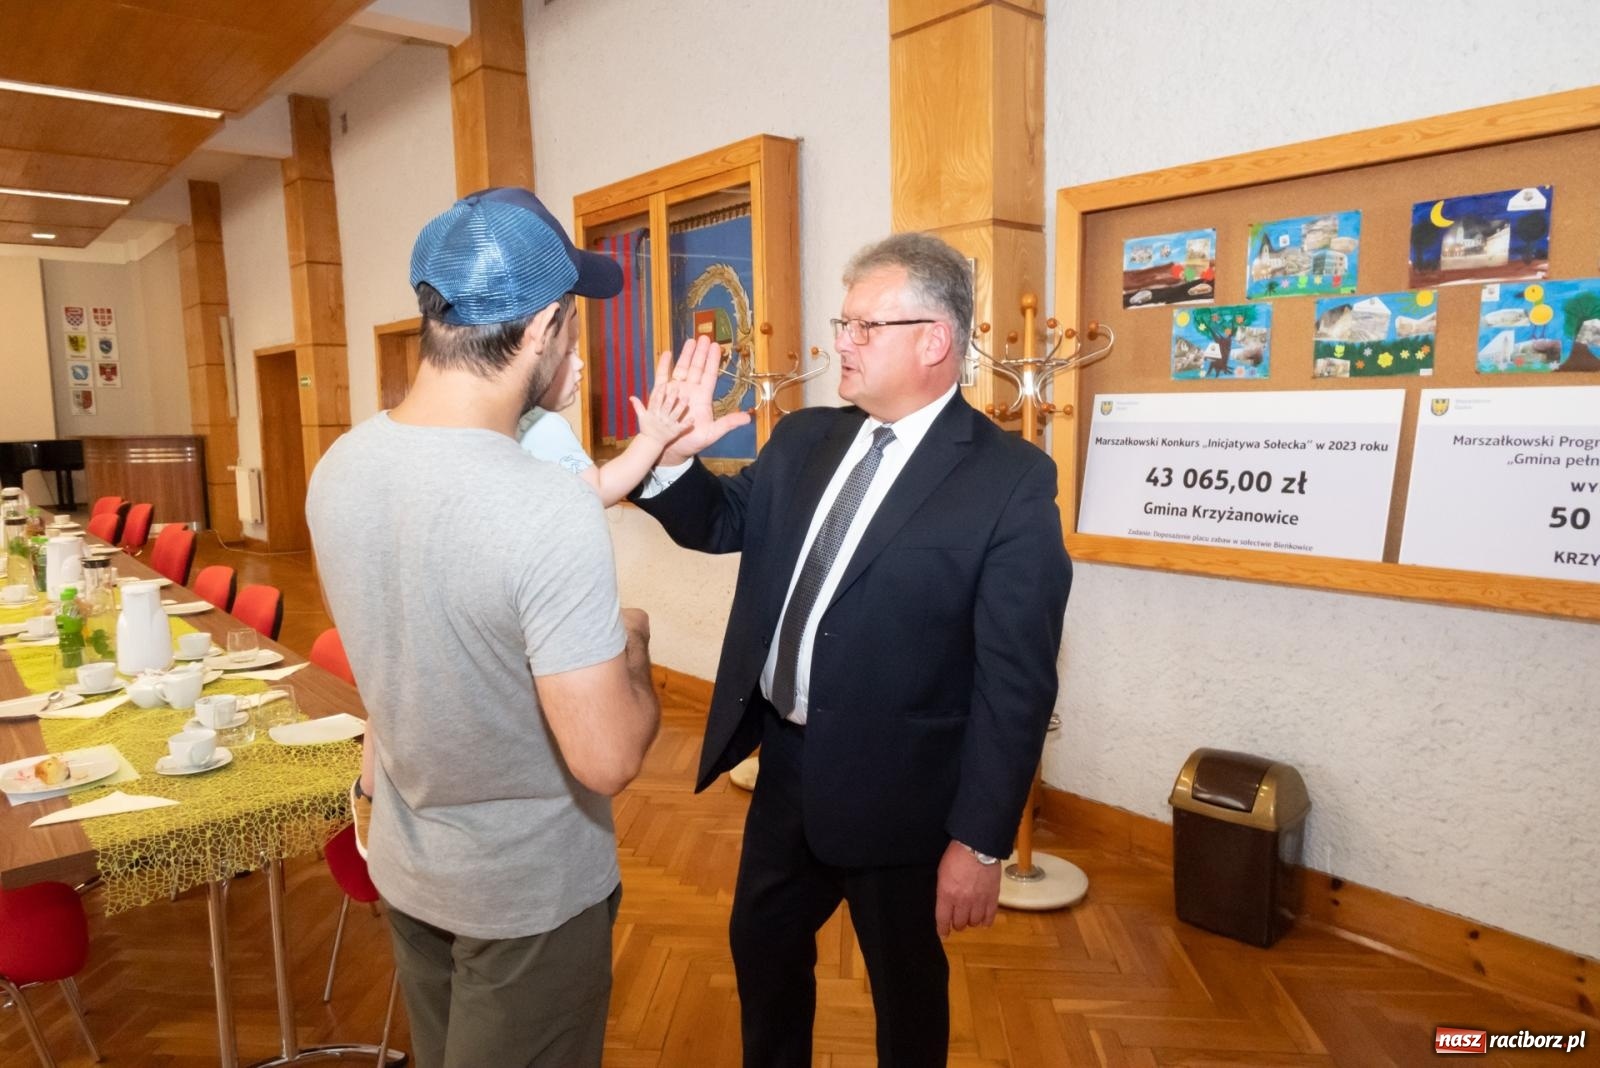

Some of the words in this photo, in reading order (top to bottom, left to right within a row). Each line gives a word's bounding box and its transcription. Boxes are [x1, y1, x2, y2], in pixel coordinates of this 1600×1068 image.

[1095, 437, 1159, 447] Marszałkowski
[1161, 438, 1200, 448] Konkurs
[1316, 441, 1326, 451] w
[1328, 440, 1357, 451] 2023
[1360, 441, 1389, 452] roku
[1453, 434, 1554, 447] Marszałkowski
[1559, 436, 1600, 451] Progr
[1565, 455, 1600, 468] pełn
[1145, 466, 1173, 488] 43
[1183, 468, 1272, 495] 065,00
[1281, 470, 1308, 495] zł
[1570, 481, 1600, 493] WY
[1143, 501, 1188, 518] Gmina
[1192, 504, 1299, 526] Krzyżanowice
[1549, 506, 1591, 530] 50
[1554, 551, 1600, 566] KRZY
